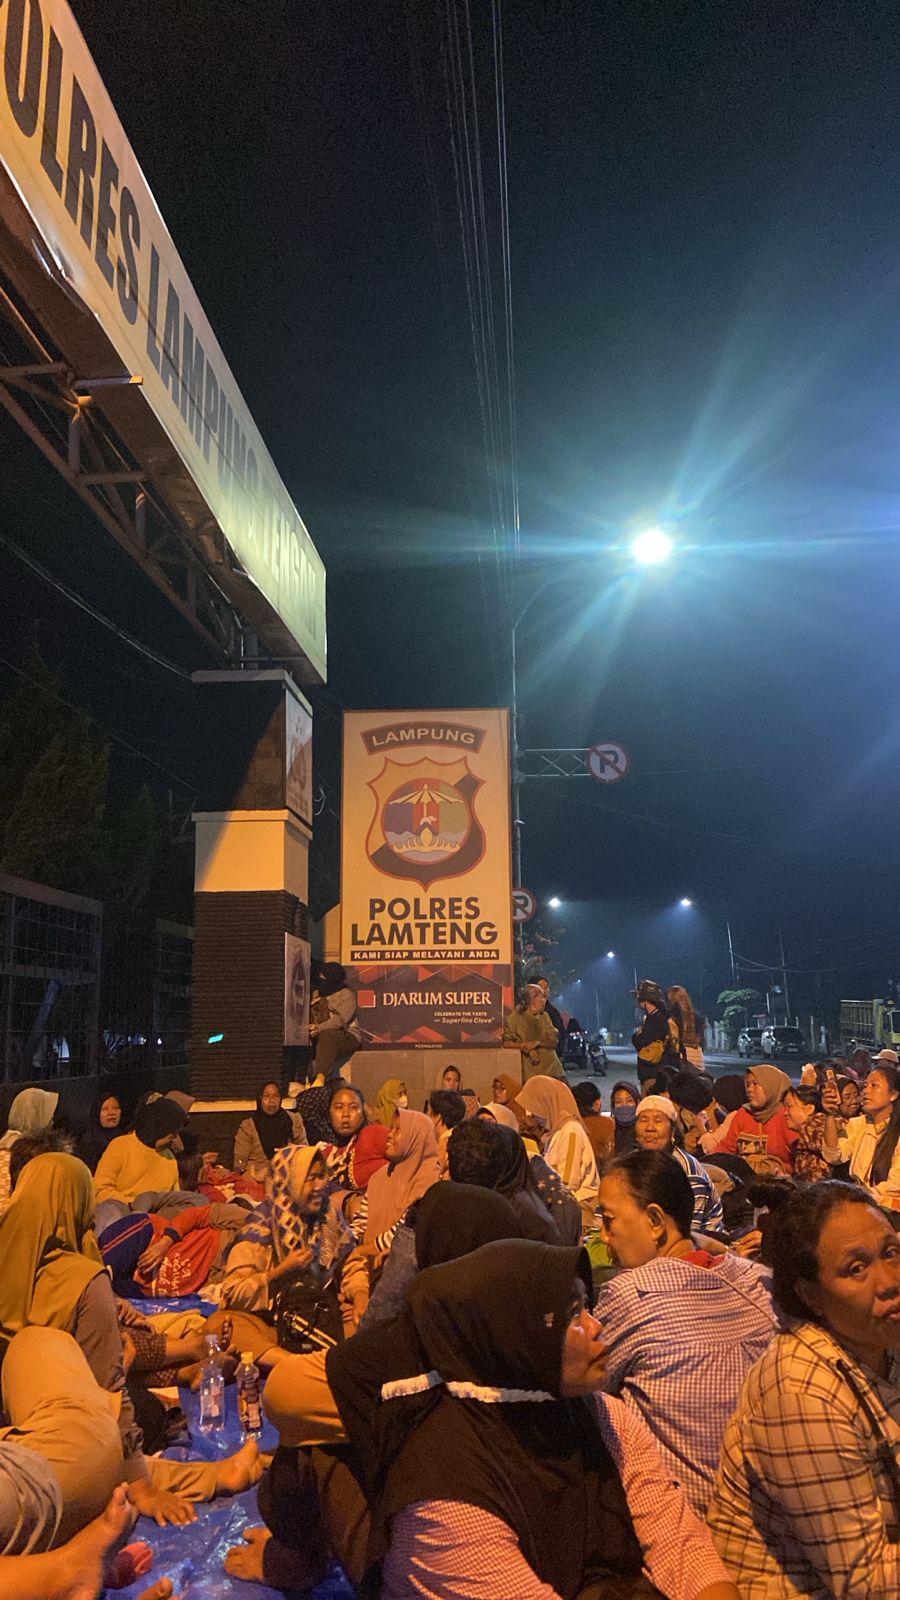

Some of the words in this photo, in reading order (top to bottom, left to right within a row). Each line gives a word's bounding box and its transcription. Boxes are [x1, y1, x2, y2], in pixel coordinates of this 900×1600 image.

[0, 0, 141, 325] OLRES
[372, 728, 476, 747] LAMPUNG
[369, 897, 481, 921] POLRES
[351, 922, 498, 946] LAMTENG
[354, 952, 381, 960] KAMI
[385, 951, 409, 959] SIAP
[412, 951, 465, 959] MELAYANI
[468, 950, 497, 959] ANDA
[383, 992, 443, 1007] DJARUM
[445, 991, 492, 1005] SUPER
